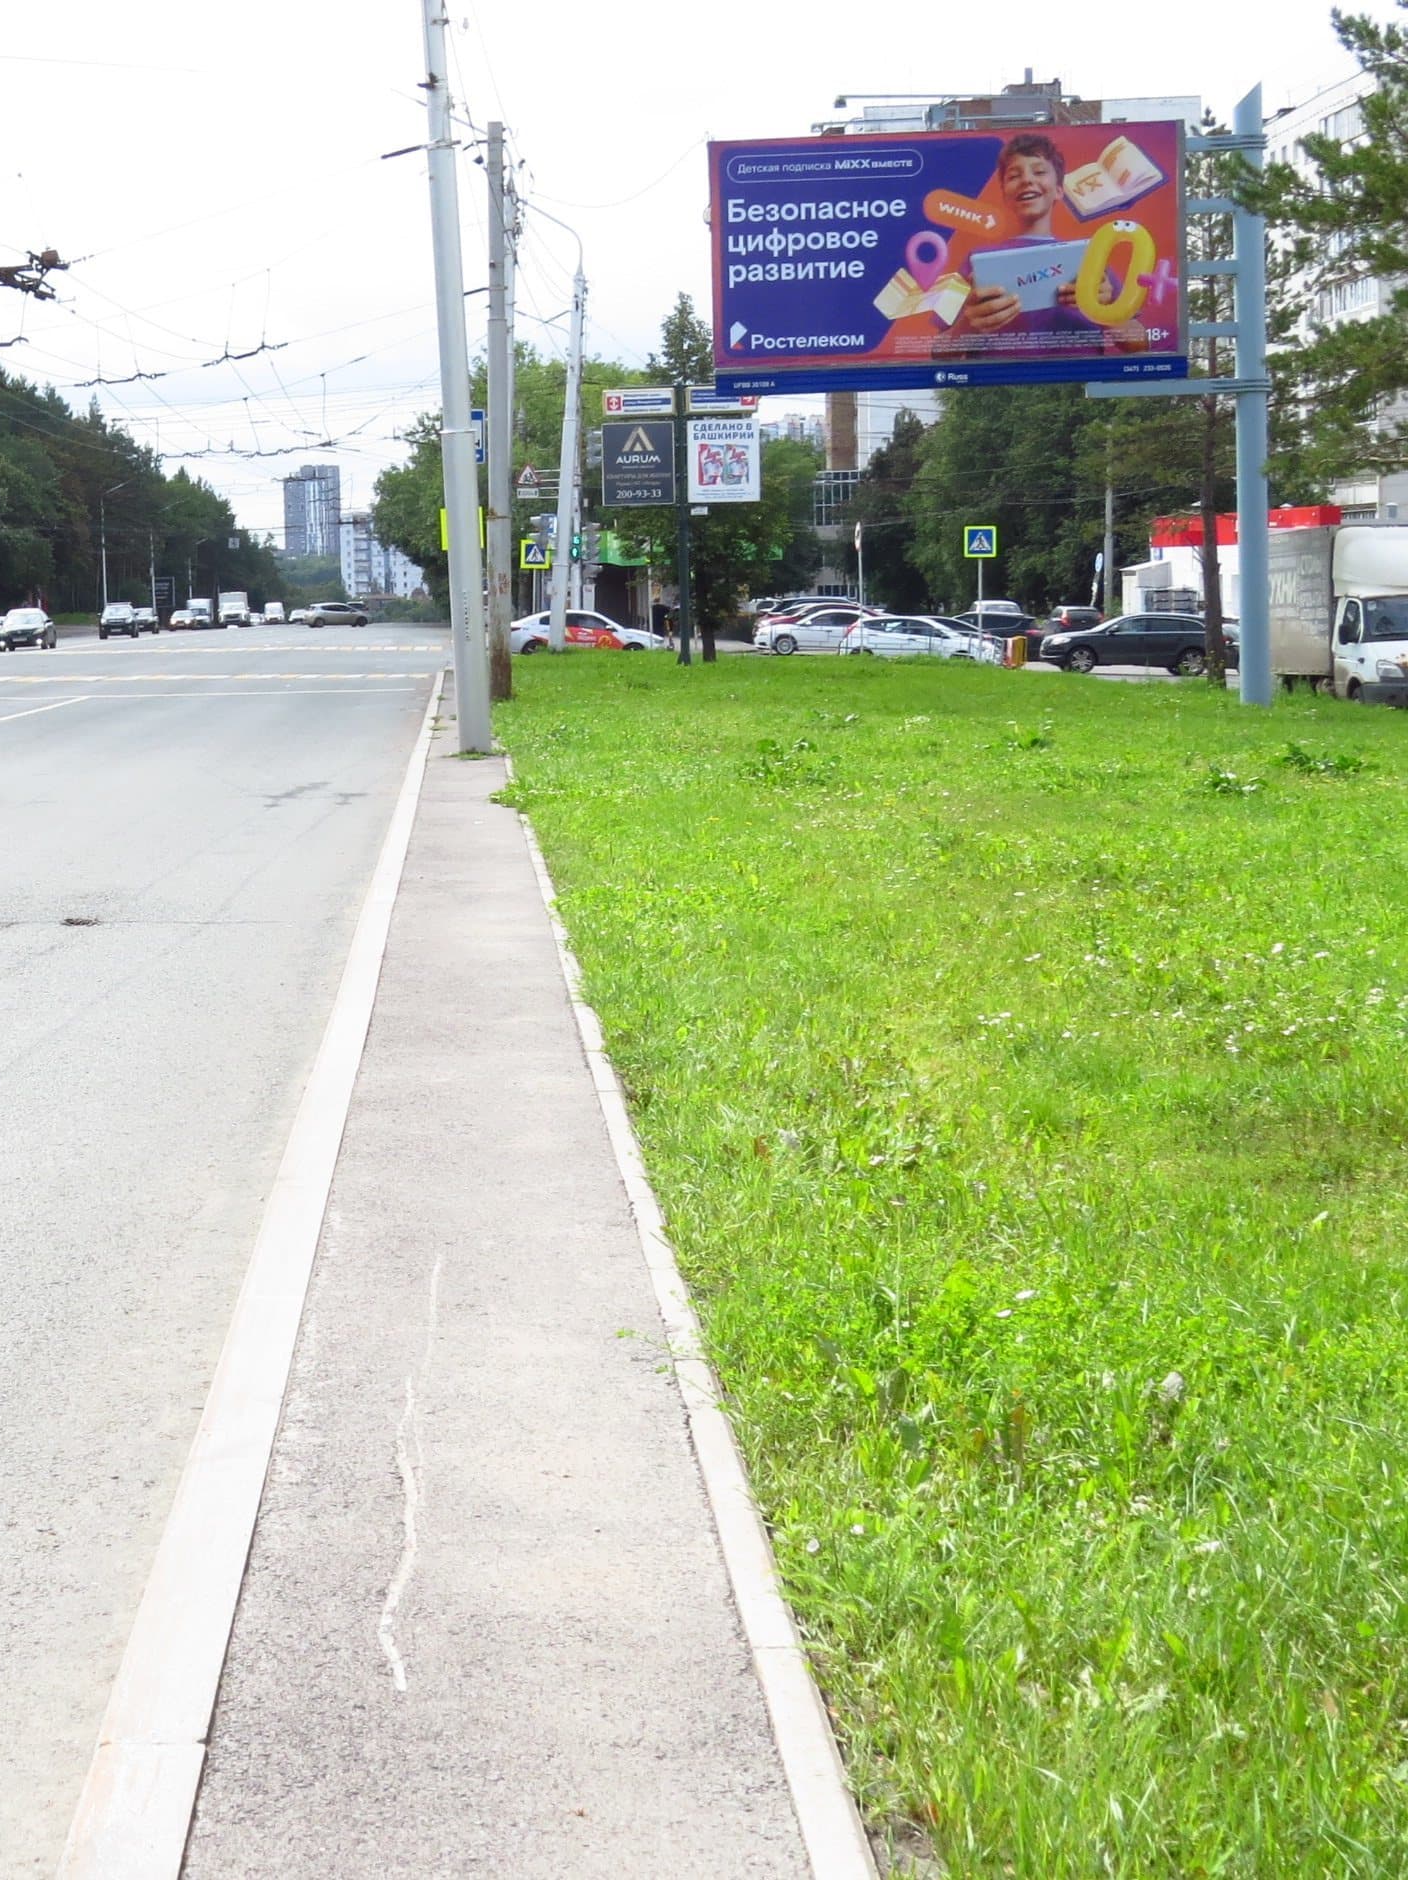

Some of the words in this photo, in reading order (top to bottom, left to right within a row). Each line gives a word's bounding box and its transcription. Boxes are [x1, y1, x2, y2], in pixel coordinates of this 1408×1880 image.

[737, 162, 780, 175] Детская
[782, 162, 832, 174] подписка
[727, 198, 907, 223] Безопасное
[938, 202, 982, 224] WINK
[727, 227, 879, 257] цифровое
[728, 259, 865, 289] развитие
[1145, 327, 1170, 341] 18+
[751, 334, 865, 350] Ростелеком
[947, 372, 969, 380] Russ
[693, 422, 743, 432] СДЕЛАНО
[746, 422, 753, 431] В
[693, 431, 754, 440] БАШКИРИИ
[615, 454, 662, 464] AURUM
[615, 488, 662, 499] 200-93-33
